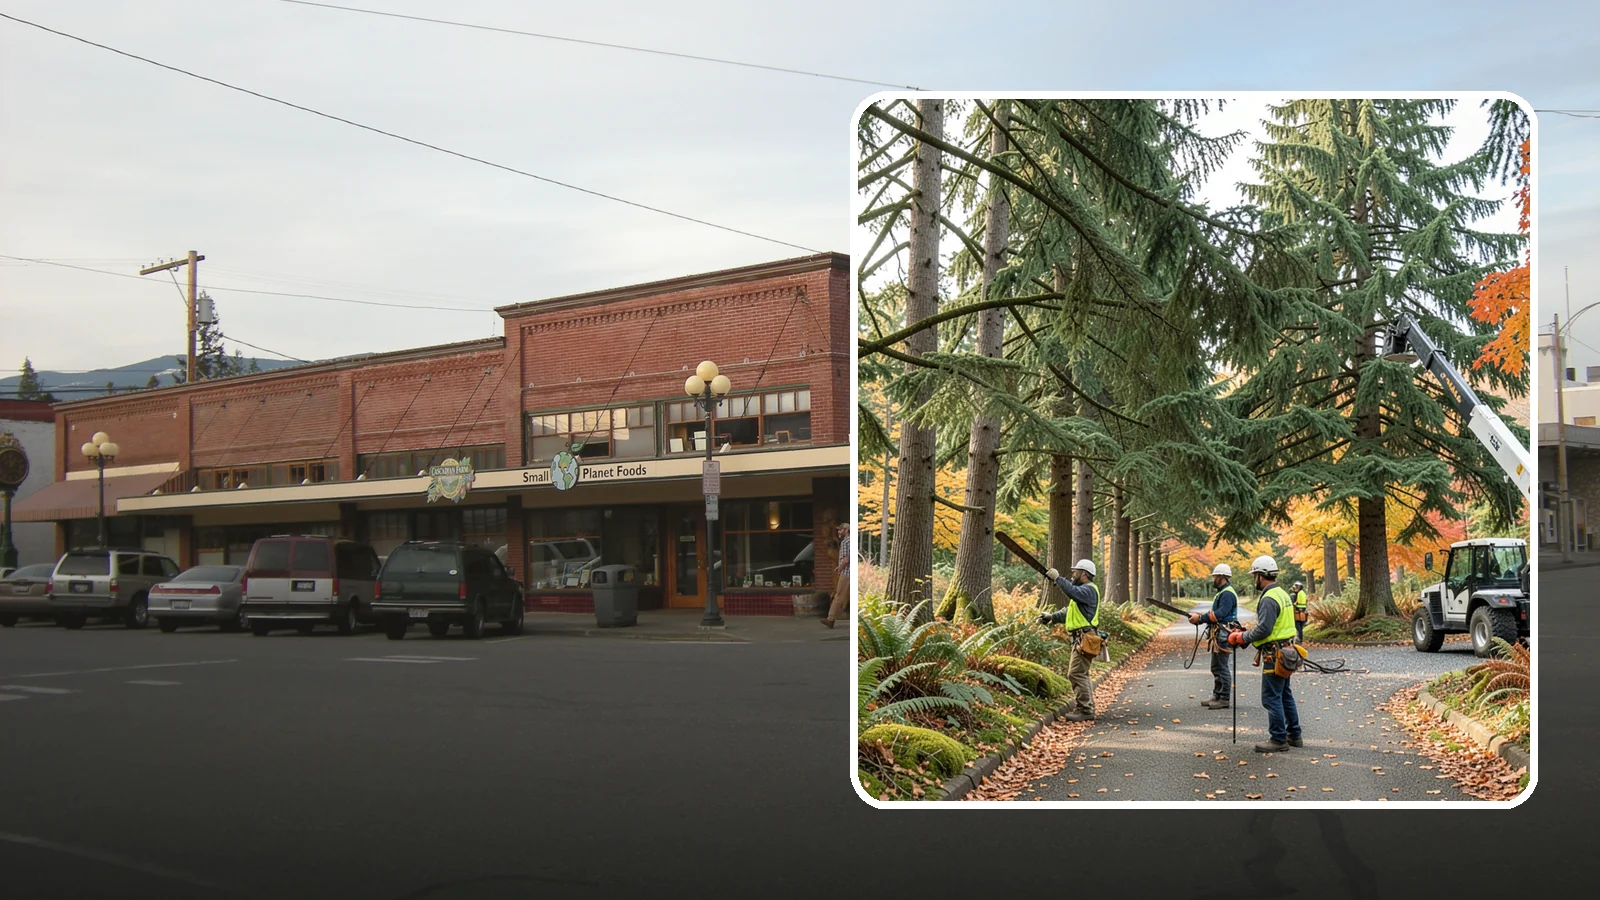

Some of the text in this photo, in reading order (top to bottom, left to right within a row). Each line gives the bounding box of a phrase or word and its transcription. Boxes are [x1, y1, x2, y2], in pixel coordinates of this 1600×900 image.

[523, 464, 647, 483] Small Planet Foods
